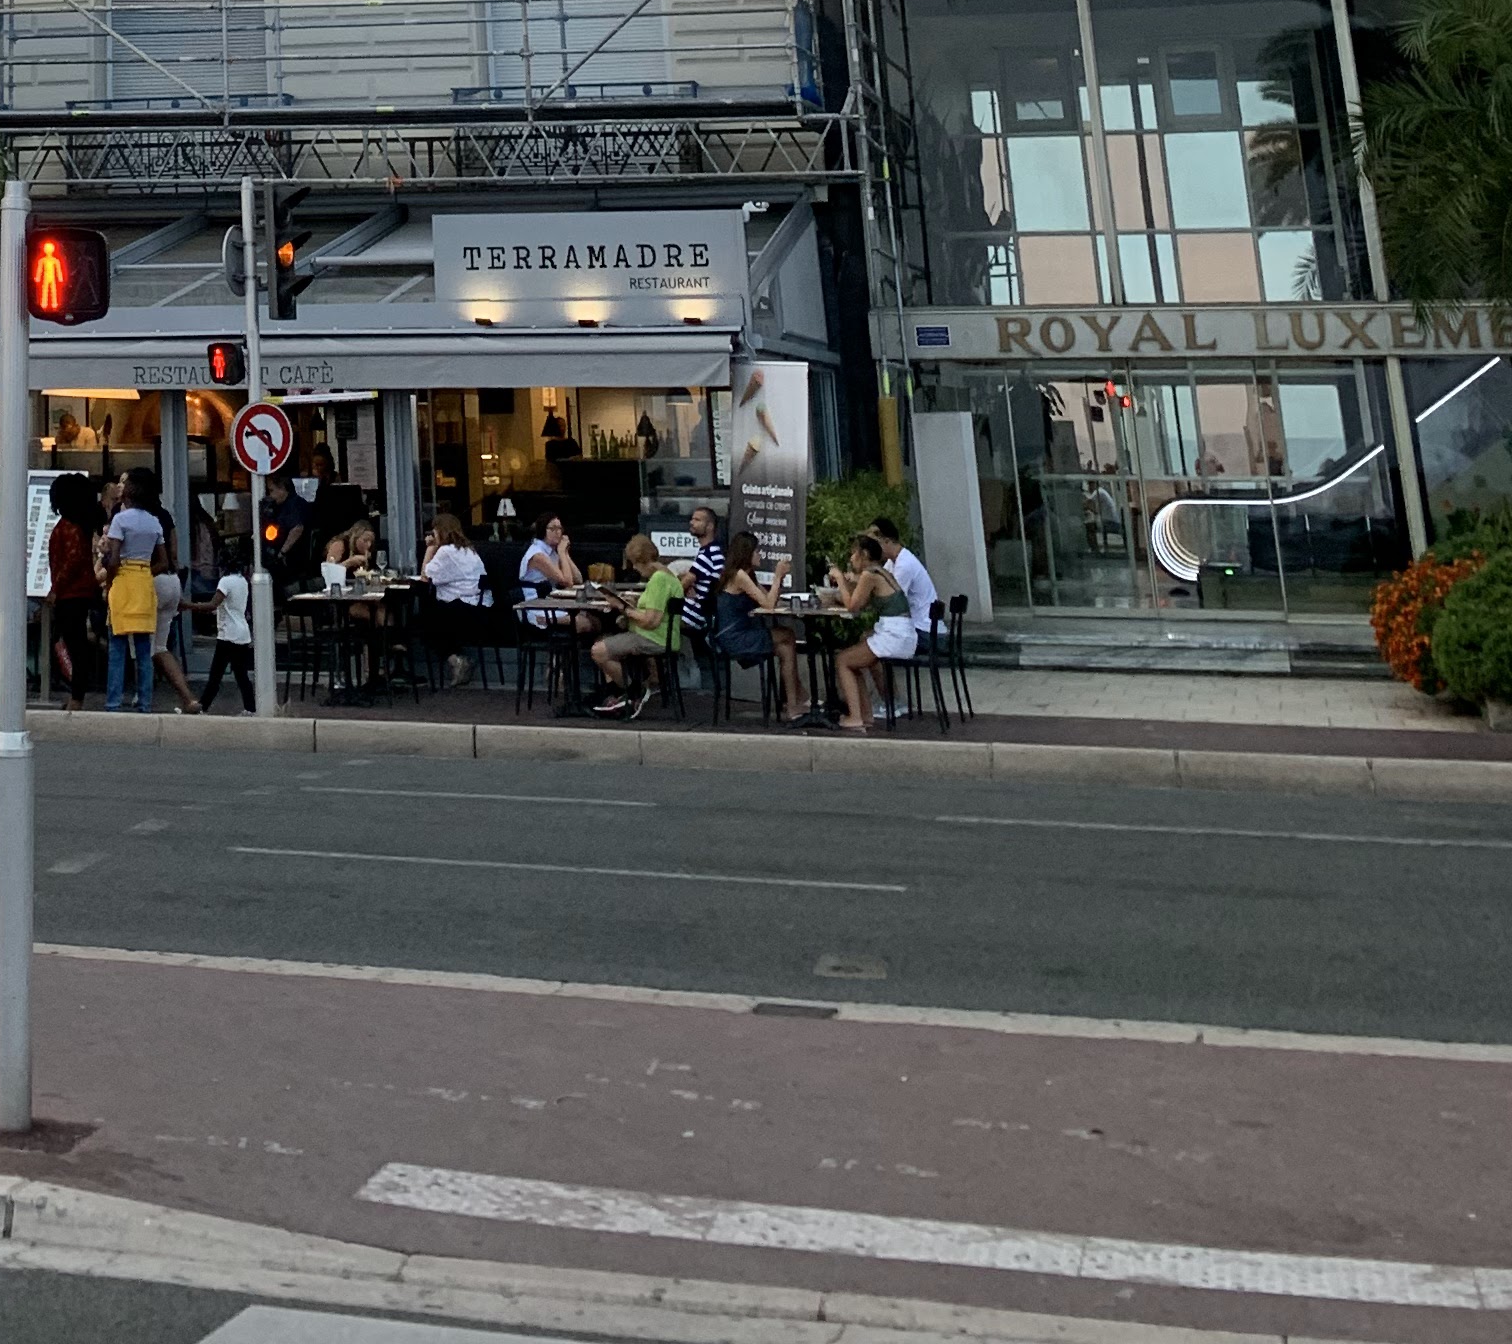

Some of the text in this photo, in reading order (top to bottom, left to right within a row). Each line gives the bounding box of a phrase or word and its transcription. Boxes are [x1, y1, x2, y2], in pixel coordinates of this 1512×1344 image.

[463, 243, 710, 270] TERRAMADRE
[629, 276, 710, 290] RESTAURANT
[995, 314, 1217, 355] ROYAL
[133, 361, 334, 385] RESTAUT CAFÈ
